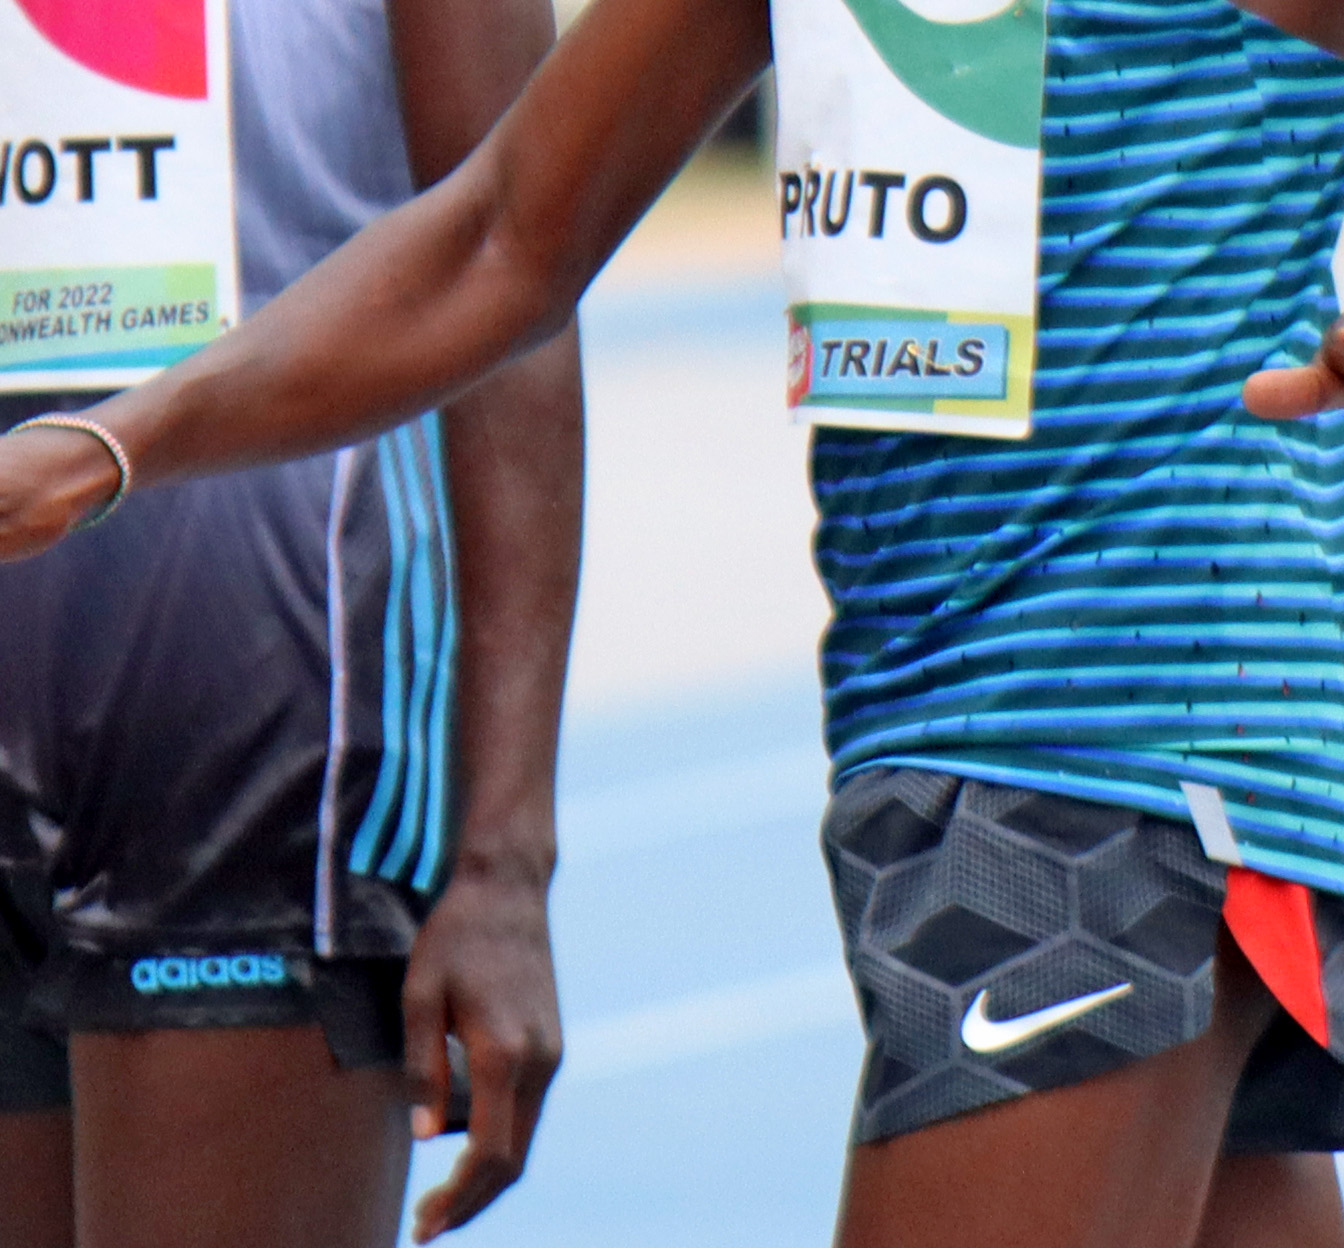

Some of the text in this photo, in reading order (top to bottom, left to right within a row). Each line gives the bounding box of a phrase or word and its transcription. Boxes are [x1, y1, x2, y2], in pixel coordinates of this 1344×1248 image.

[778, 169, 969, 245] PRUTO
[12, 282, 114, 315] FOR 2022
[121, 301, 211, 332] GAMES
[820, 338, 986, 379] TRIALS
